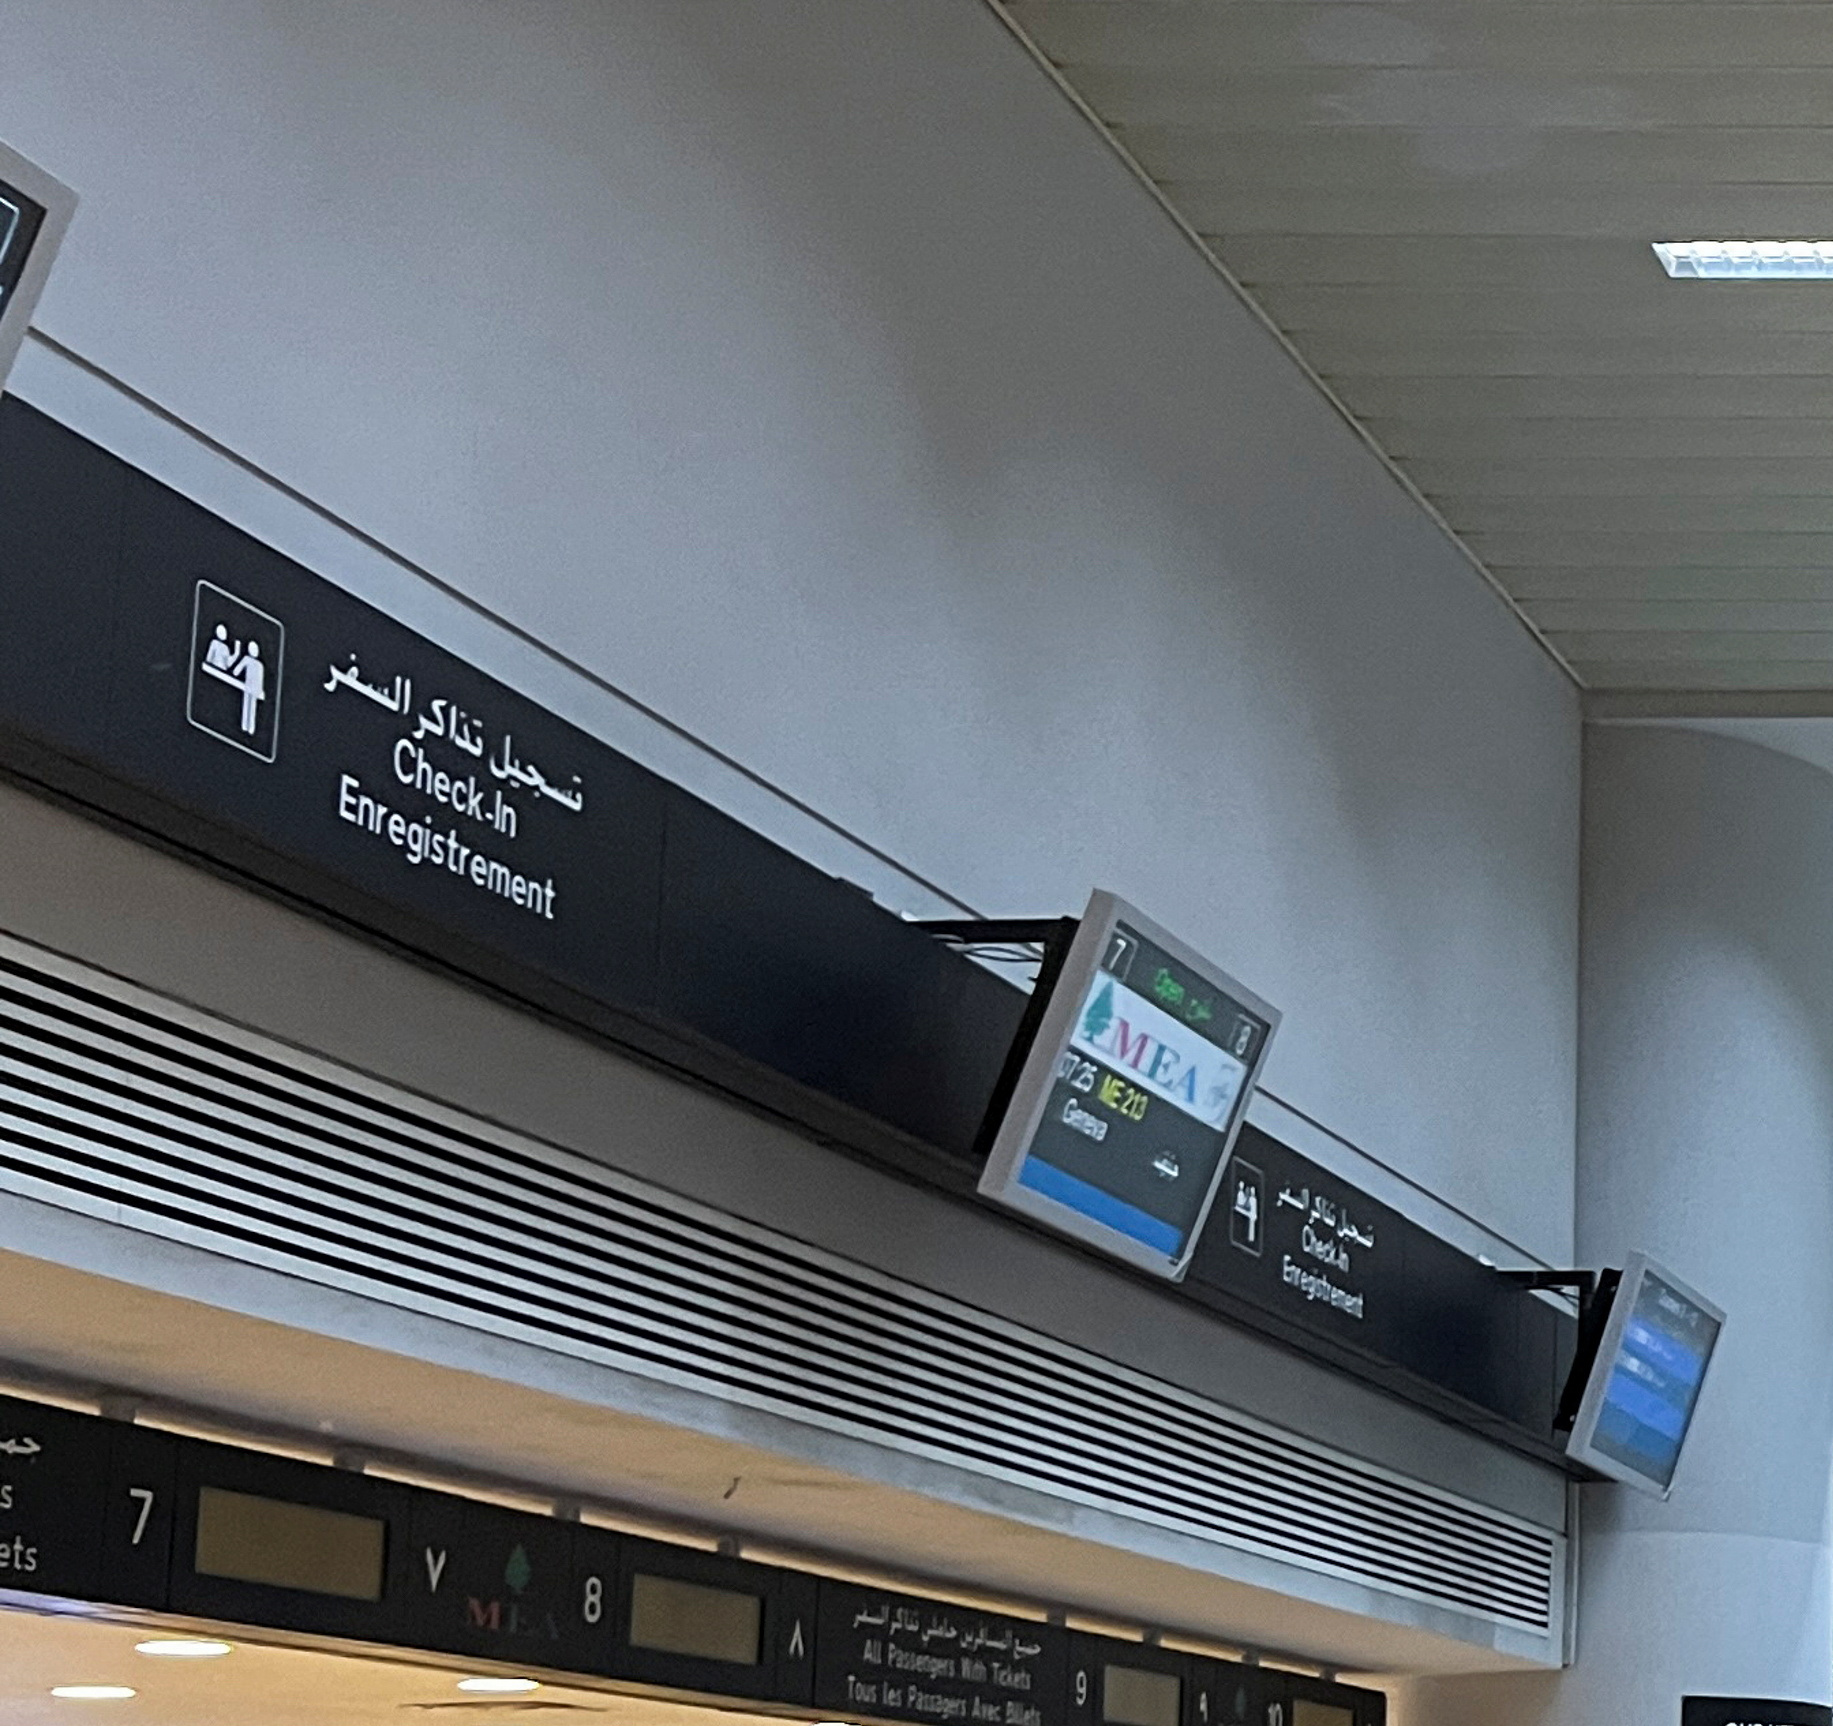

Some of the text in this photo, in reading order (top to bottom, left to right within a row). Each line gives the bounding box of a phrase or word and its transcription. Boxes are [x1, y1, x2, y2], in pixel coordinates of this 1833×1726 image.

[323, 653, 583, 812] تسجيل تذاكر السفر
[393, 738, 516, 839] Check-In
[338, 774, 556, 920] Enregistrement
[1109, 937, 1127, 971] 7
[1101, 1016, 1197, 1105] MEA
[130, 1487, 154, 1544] 7
[584, 1576, 602, 1623] 8
[1076, 1670, 1087, 1705] 9
